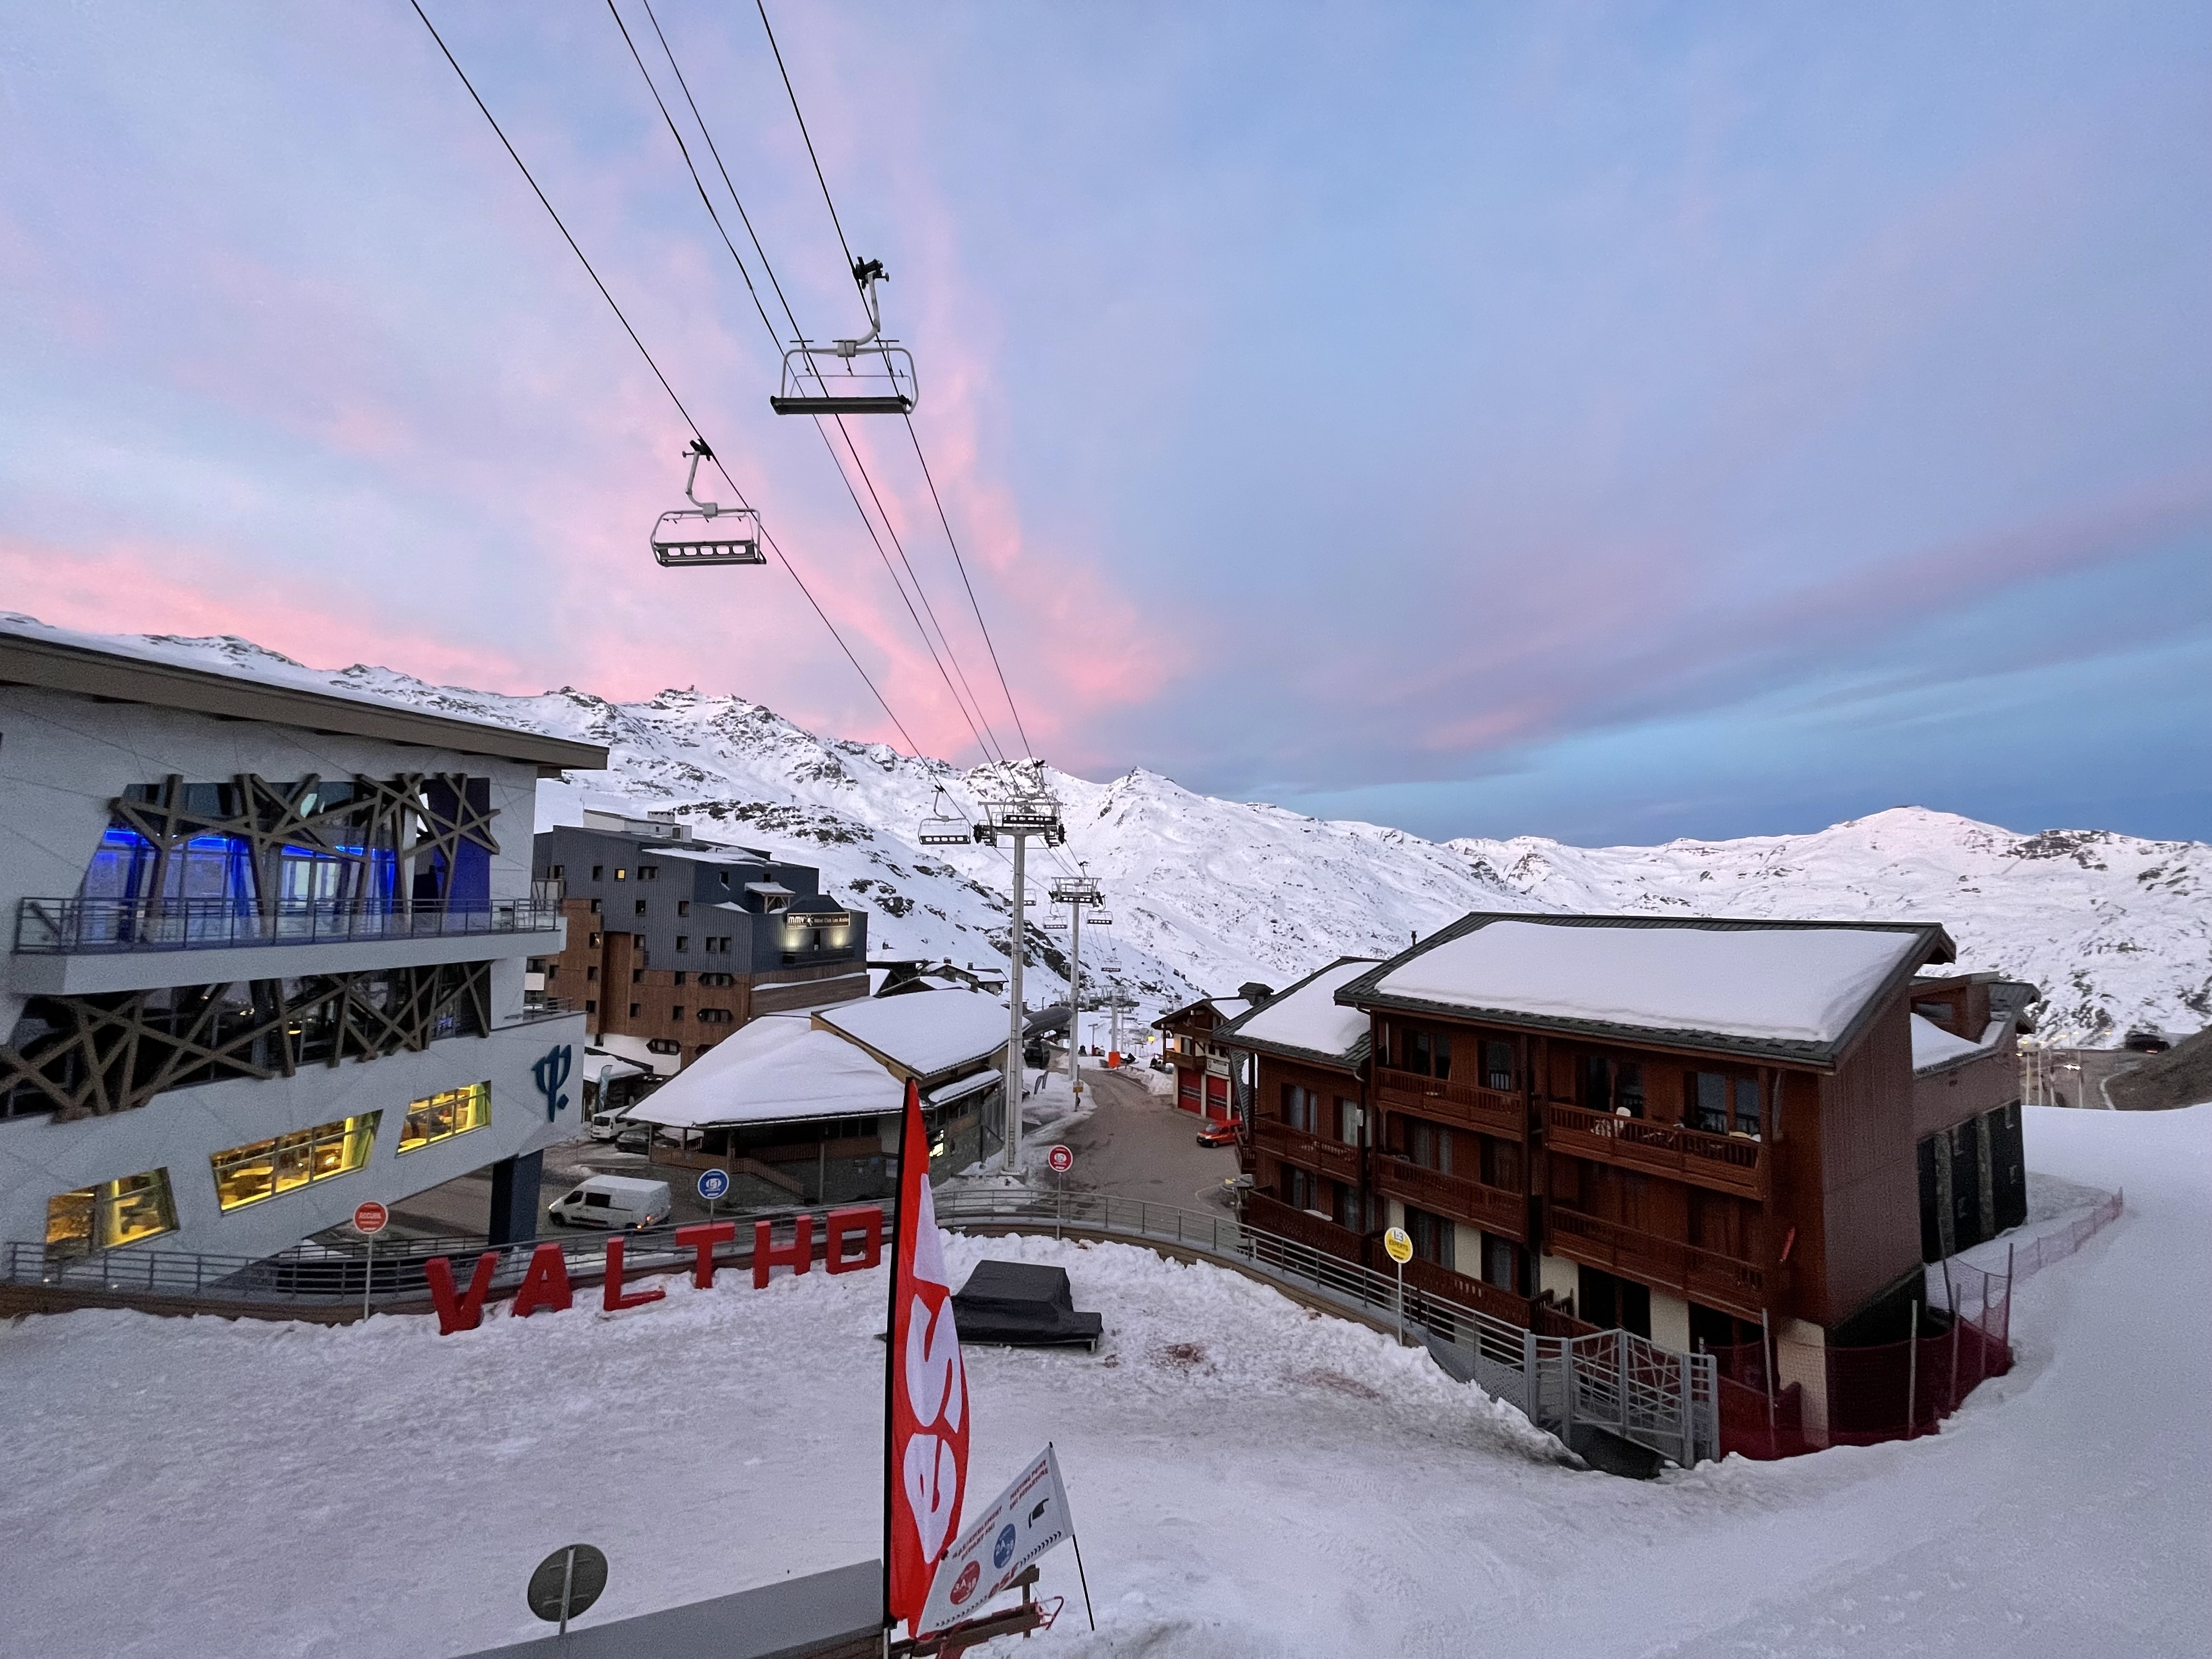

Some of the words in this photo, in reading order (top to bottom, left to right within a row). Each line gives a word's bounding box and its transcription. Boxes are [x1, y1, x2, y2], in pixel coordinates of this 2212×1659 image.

[788, 916, 805, 924] mmv
[1389, 1239, 1409, 1251] EXPERTS
[425, 1237, 666, 1336] VAL
[1010, 1474, 1031, 1500] MEETING
[1031, 1459, 1046, 1477] POINT
[995, 1539, 1006, 1556] 2A
[953, 1578, 967, 1593] 3A
